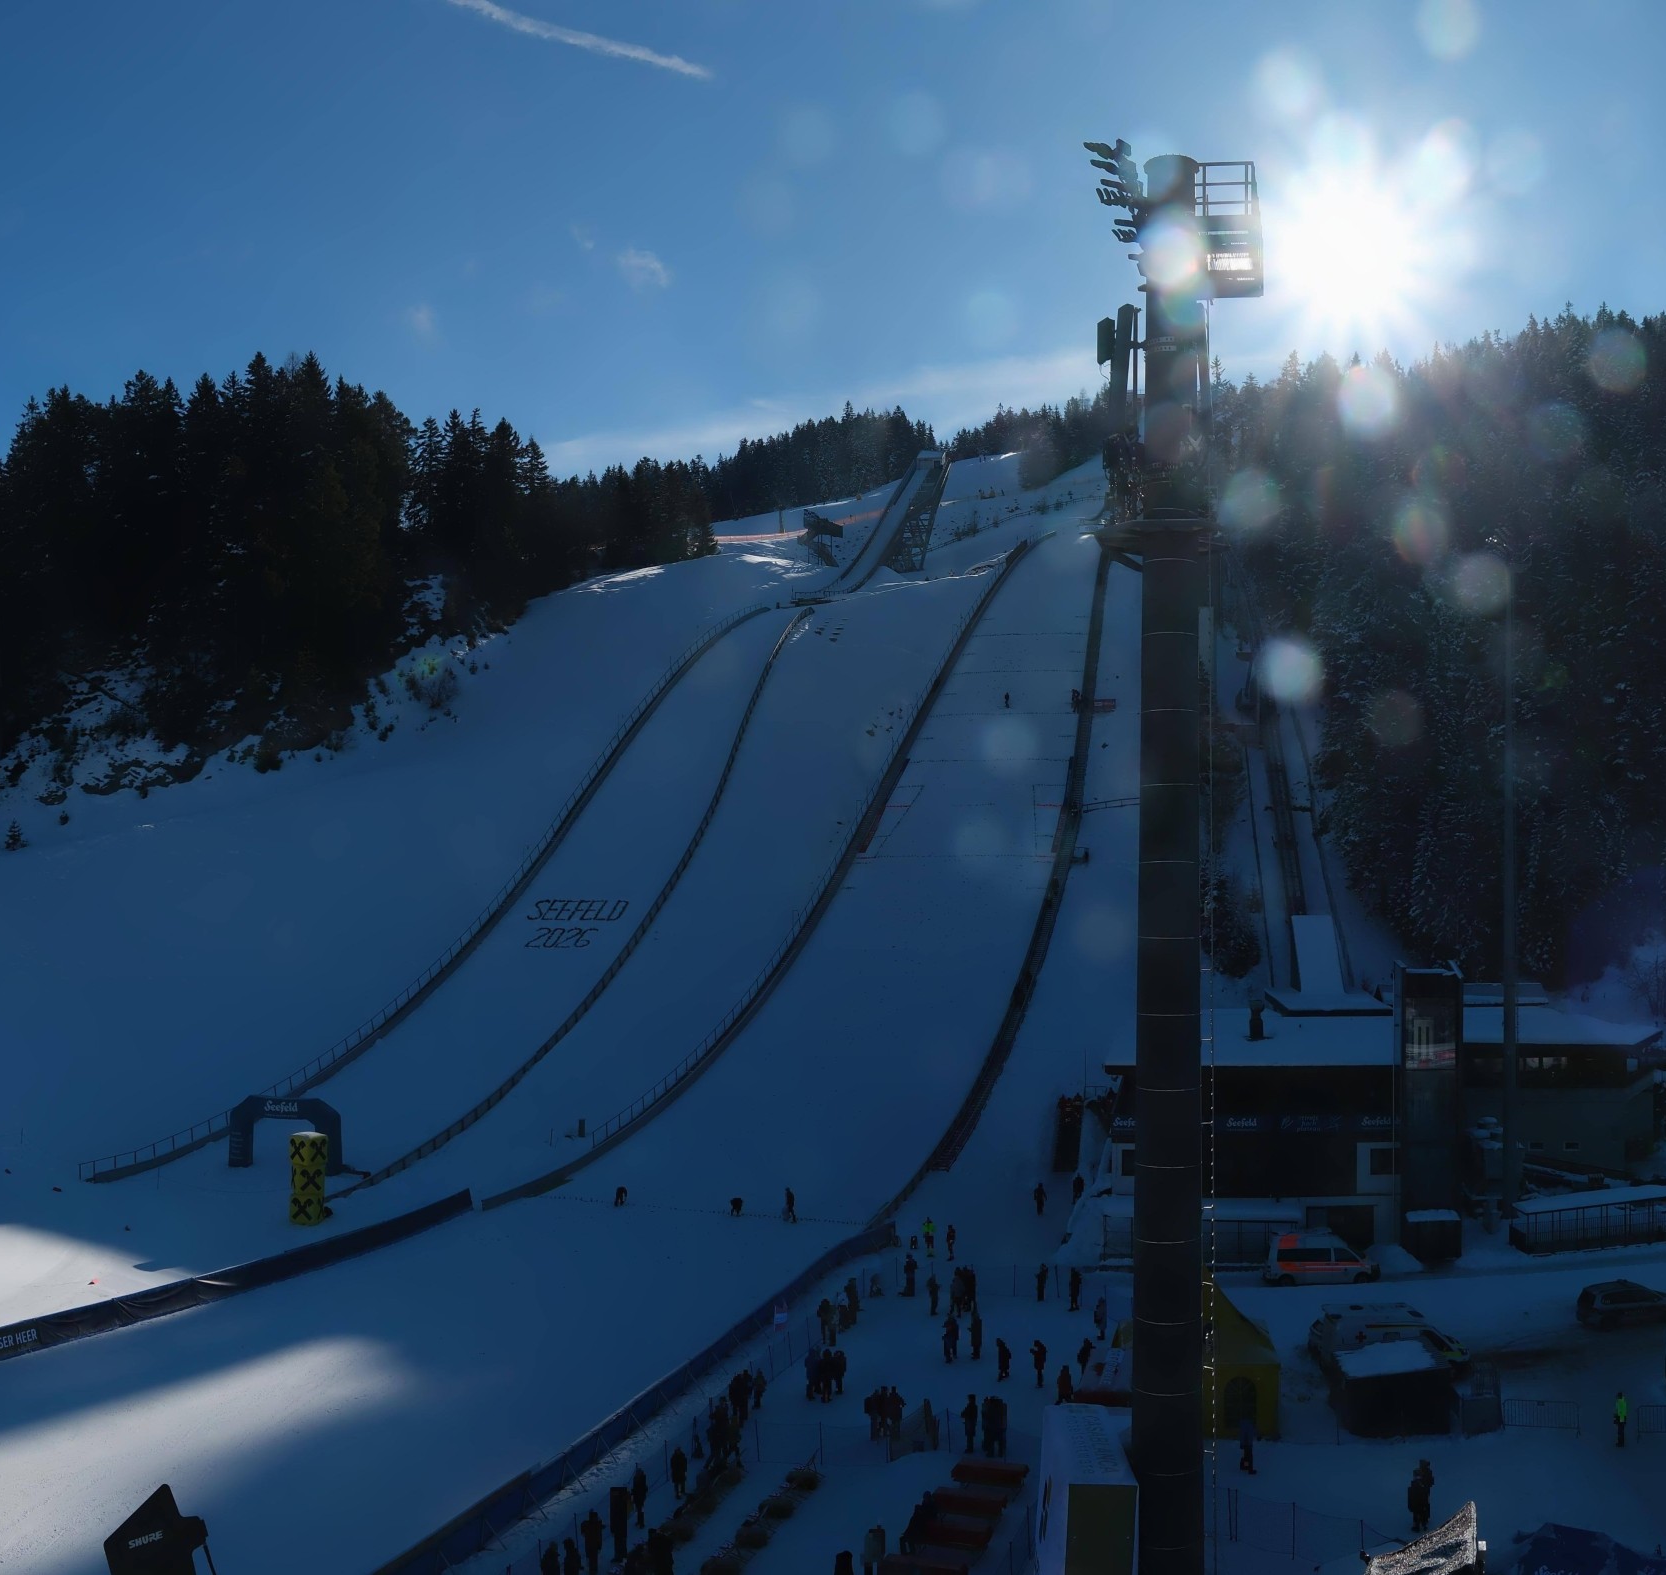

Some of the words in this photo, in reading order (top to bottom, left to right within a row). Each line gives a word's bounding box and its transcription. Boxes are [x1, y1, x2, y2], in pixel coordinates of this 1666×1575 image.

[527, 899, 629, 921] SEEFELD
[524, 927, 599, 949] 2026
[264, 1100, 298, 1113] Seefeld
[1112, 1116, 1135, 1127] Seefe
[1226, 1117, 1257, 1129] Seefeld
[1361, 1115, 1392, 1127] Seefeld
[15, 1328, 38, 1348] HEER
[128, 1530, 164, 1550] SHURE
